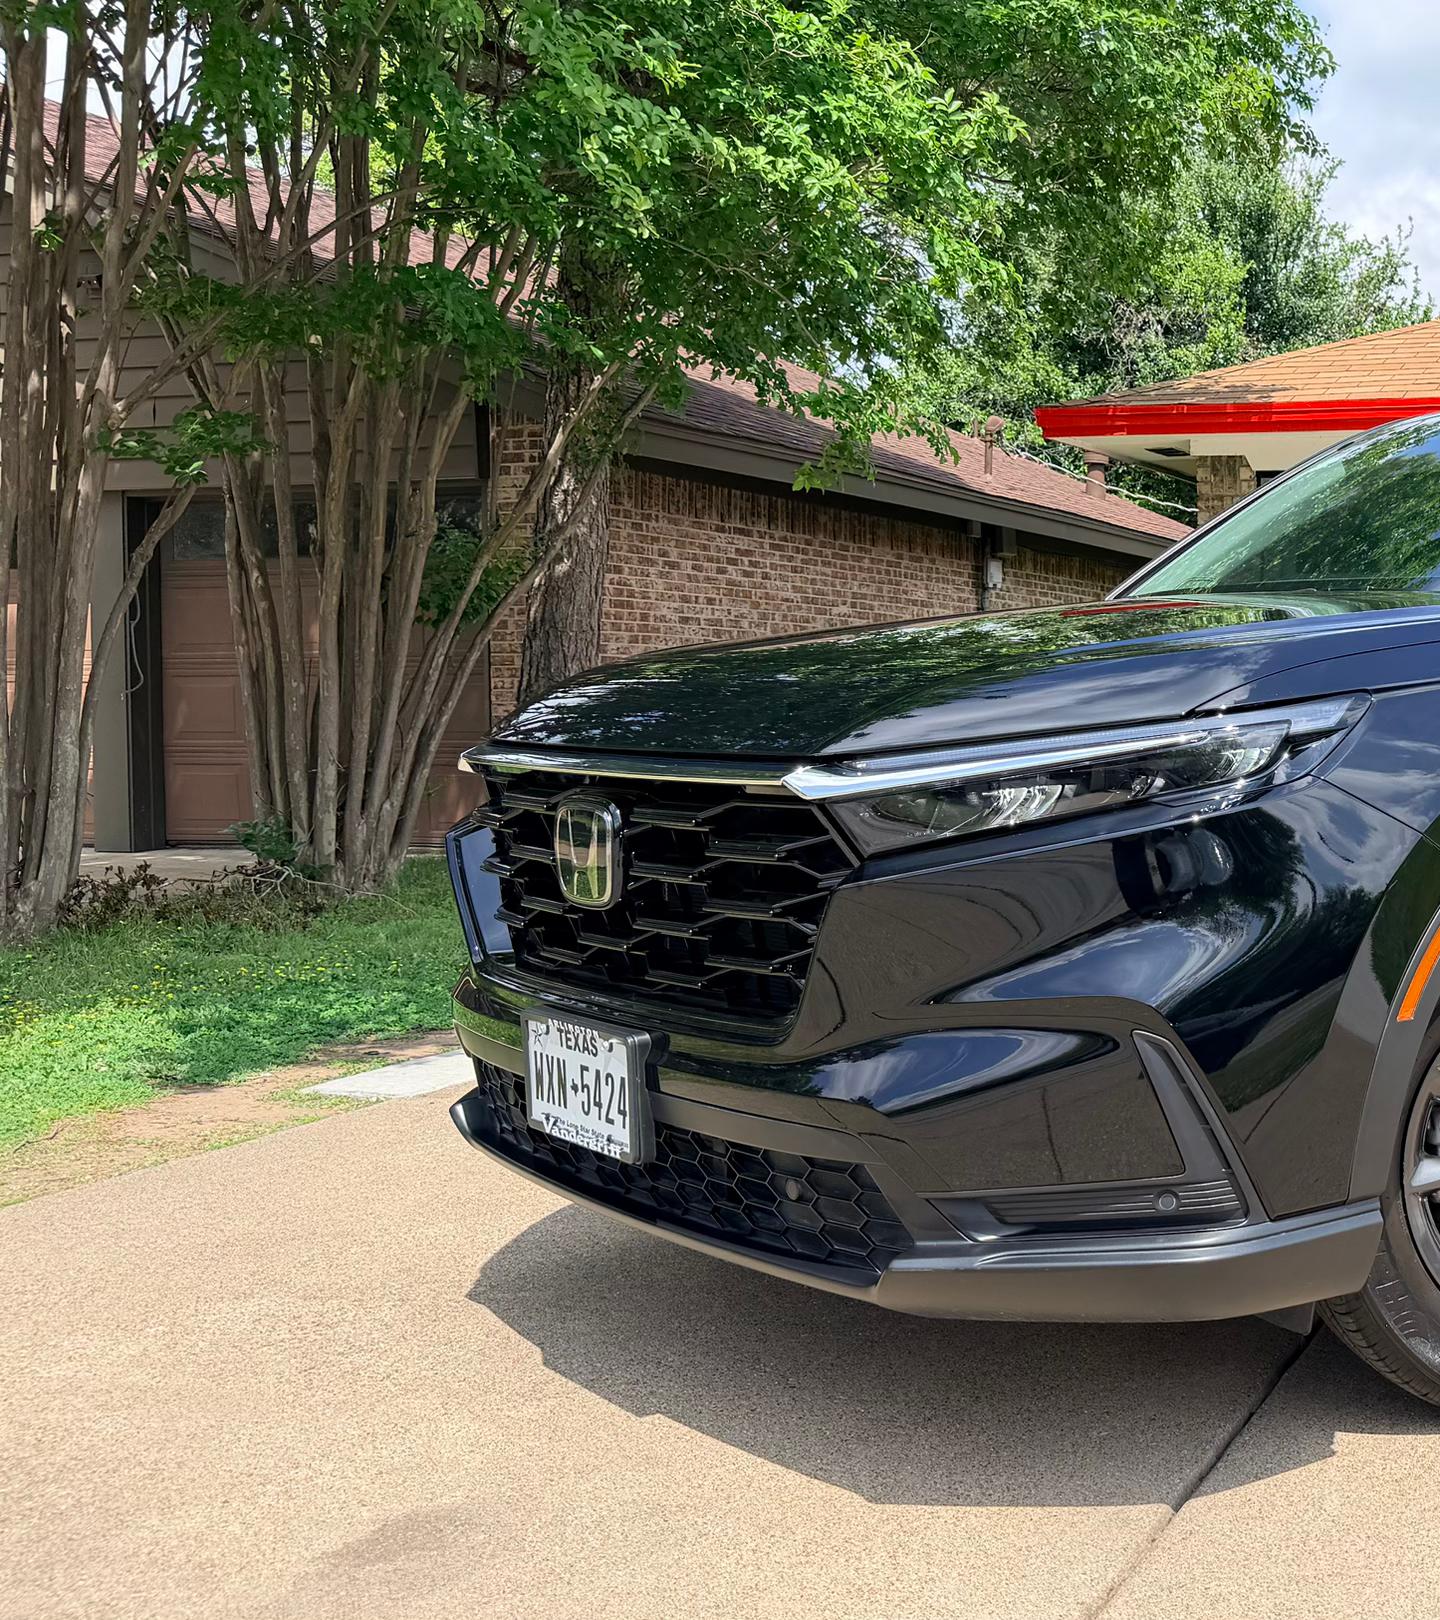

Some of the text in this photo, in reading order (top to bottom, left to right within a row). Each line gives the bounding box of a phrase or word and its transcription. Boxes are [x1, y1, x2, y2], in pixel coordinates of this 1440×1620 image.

[548, 1018, 601, 1040] ARLINGTON
[556, 1027, 599, 1058] TEXAS
[579, 1063, 629, 1130] 5424
[543, 1115, 622, 1159] Vandergriff
